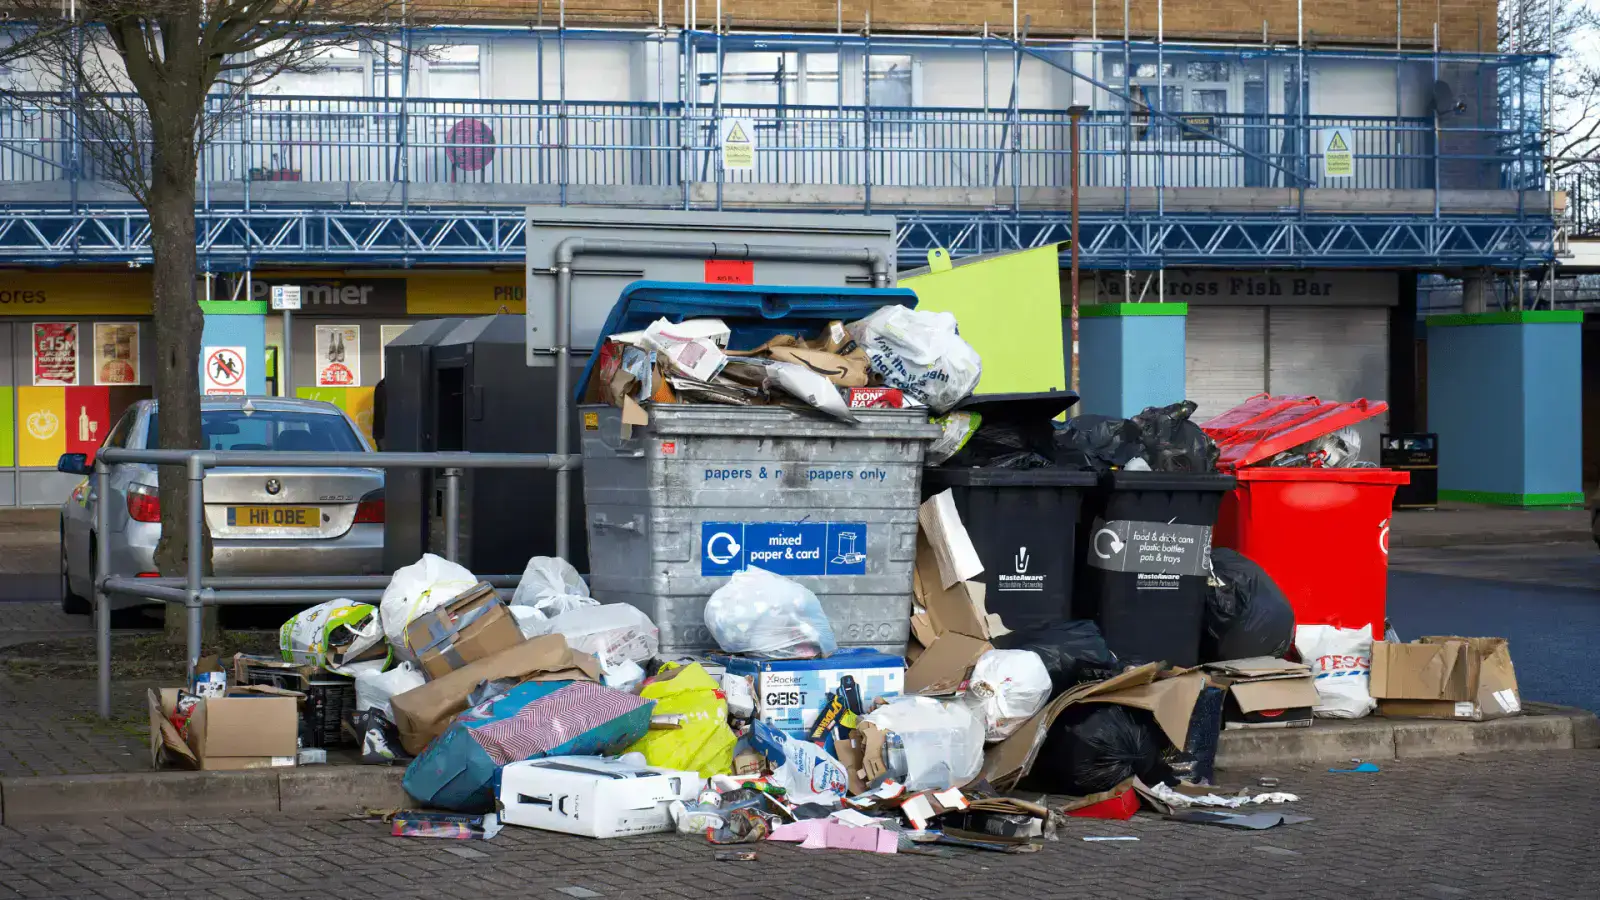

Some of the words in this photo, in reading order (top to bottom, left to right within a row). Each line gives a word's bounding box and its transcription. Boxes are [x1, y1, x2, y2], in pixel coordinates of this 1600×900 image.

[251, 280, 374, 305] Pmier
[1229, 278, 1283, 296] Fish
[1292, 278, 1333, 296] Bar
[704, 467, 752, 481] papers
[758, 466, 768, 479] &
[775, 468, 854, 482] nspapers
[859, 468, 887, 483] only
[768, 533, 802, 546] mixed
[1133, 531, 1150, 541] food
[1152, 531, 1158, 542] &
[1177, 534, 1194, 544] cans
[750, 549, 782, 563] paper
[784, 548, 794, 560] &
[795, 547, 820, 560] card
[1139, 543, 1160, 553] plastic
[1161, 544, 1185, 553] bottles
[1139, 554, 1155, 564] pots
[1155, 554, 1162, 562] &
[1163, 554, 1181, 565] trays
[1315, 654, 1370, 672] TESC
[766, 691, 808, 706] GEIST
